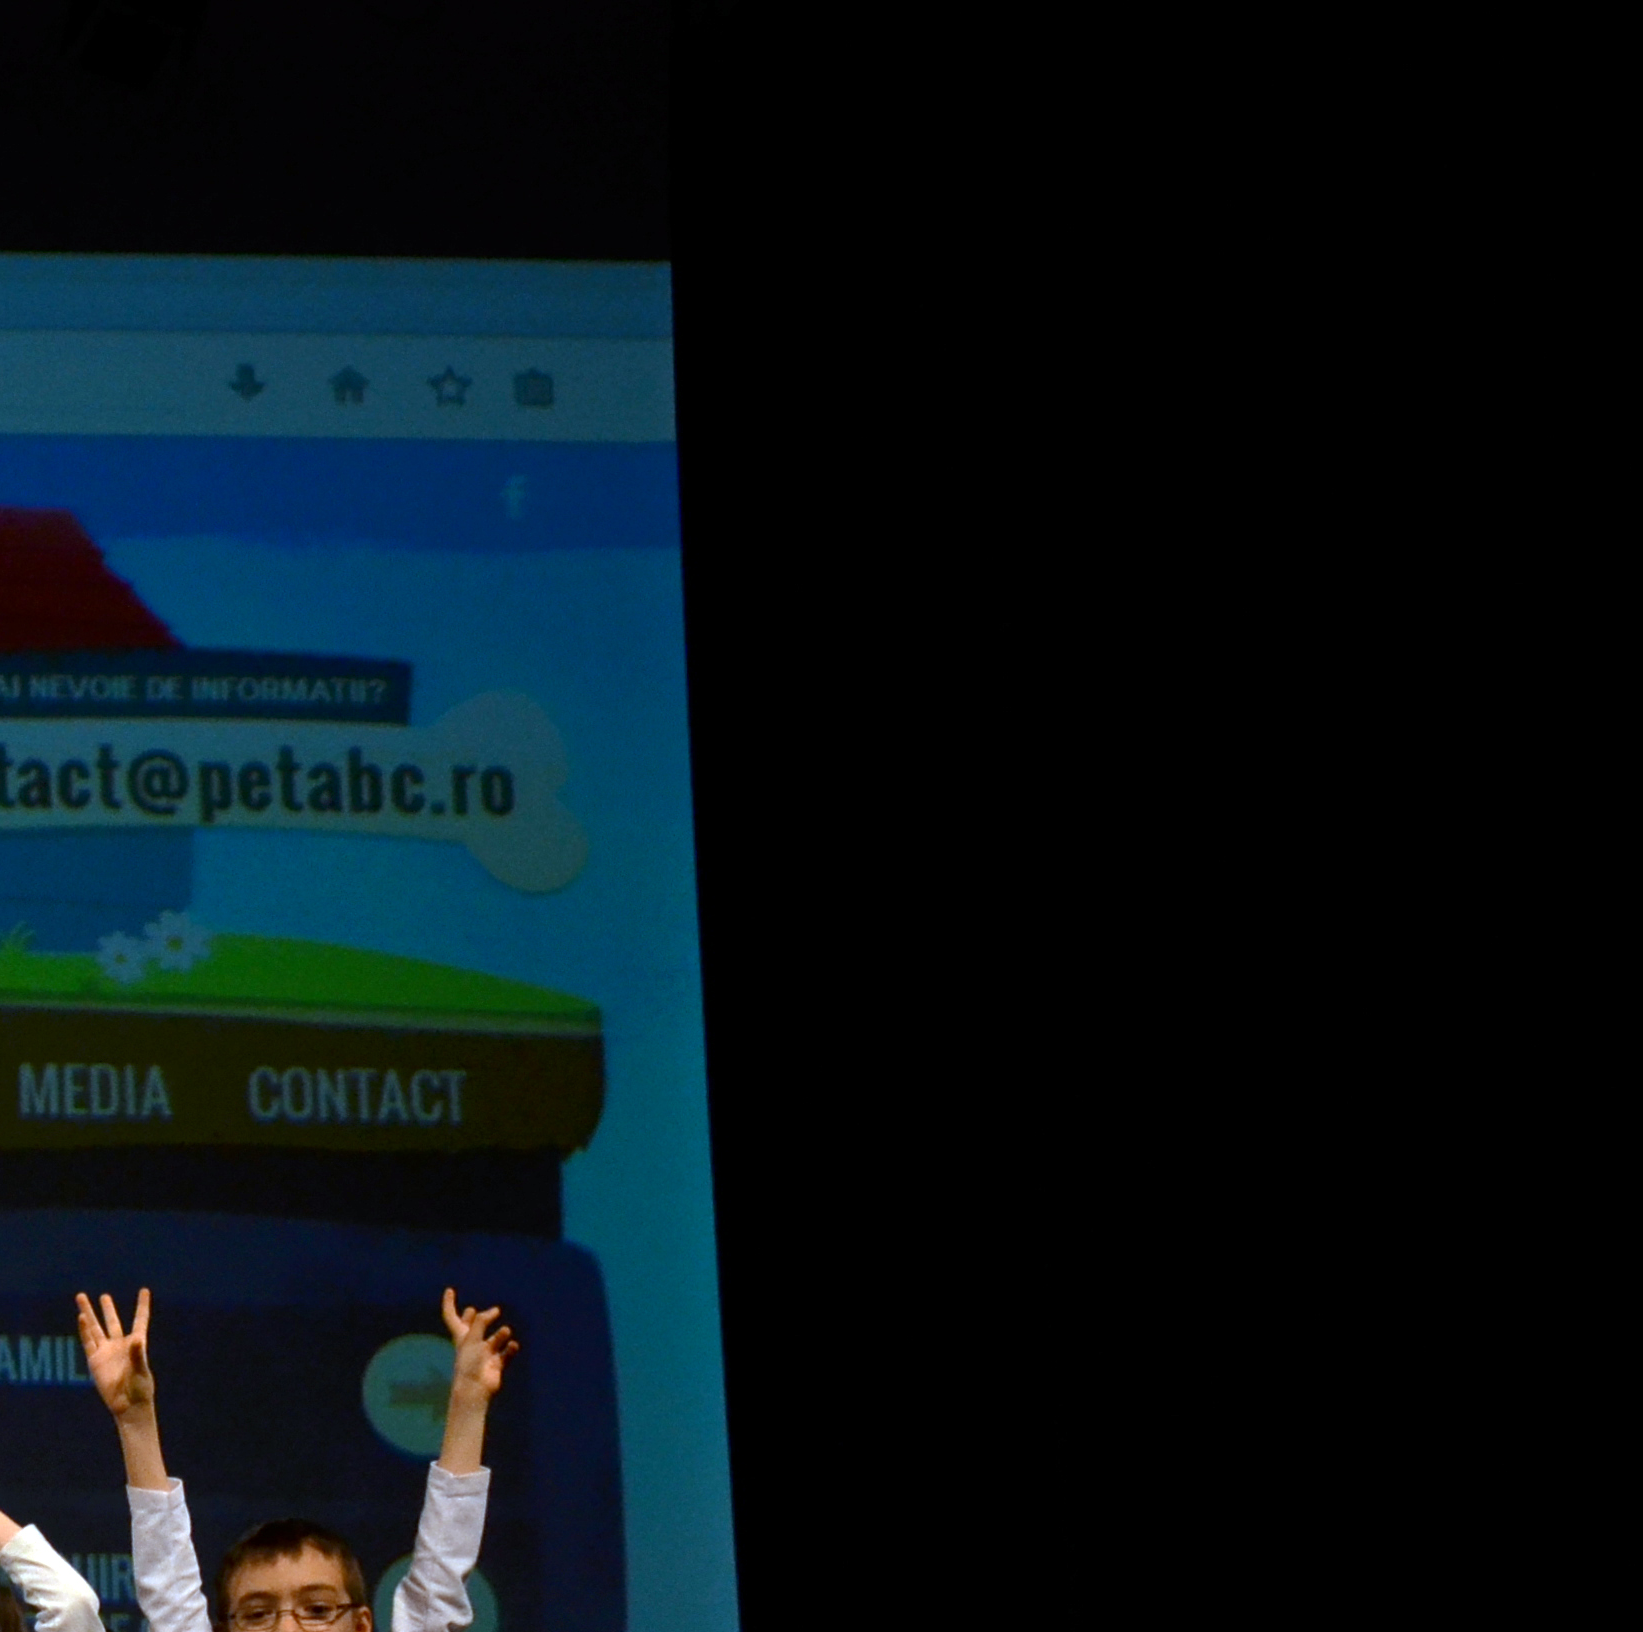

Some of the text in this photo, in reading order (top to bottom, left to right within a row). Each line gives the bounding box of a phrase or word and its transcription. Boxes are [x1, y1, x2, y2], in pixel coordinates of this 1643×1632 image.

[28, 674, 138, 700] NEVOIE
[146, 675, 184, 701] DE
[17, 1061, 173, 1121] MEDIA
[247, 1065, 467, 1127] CONTACT
